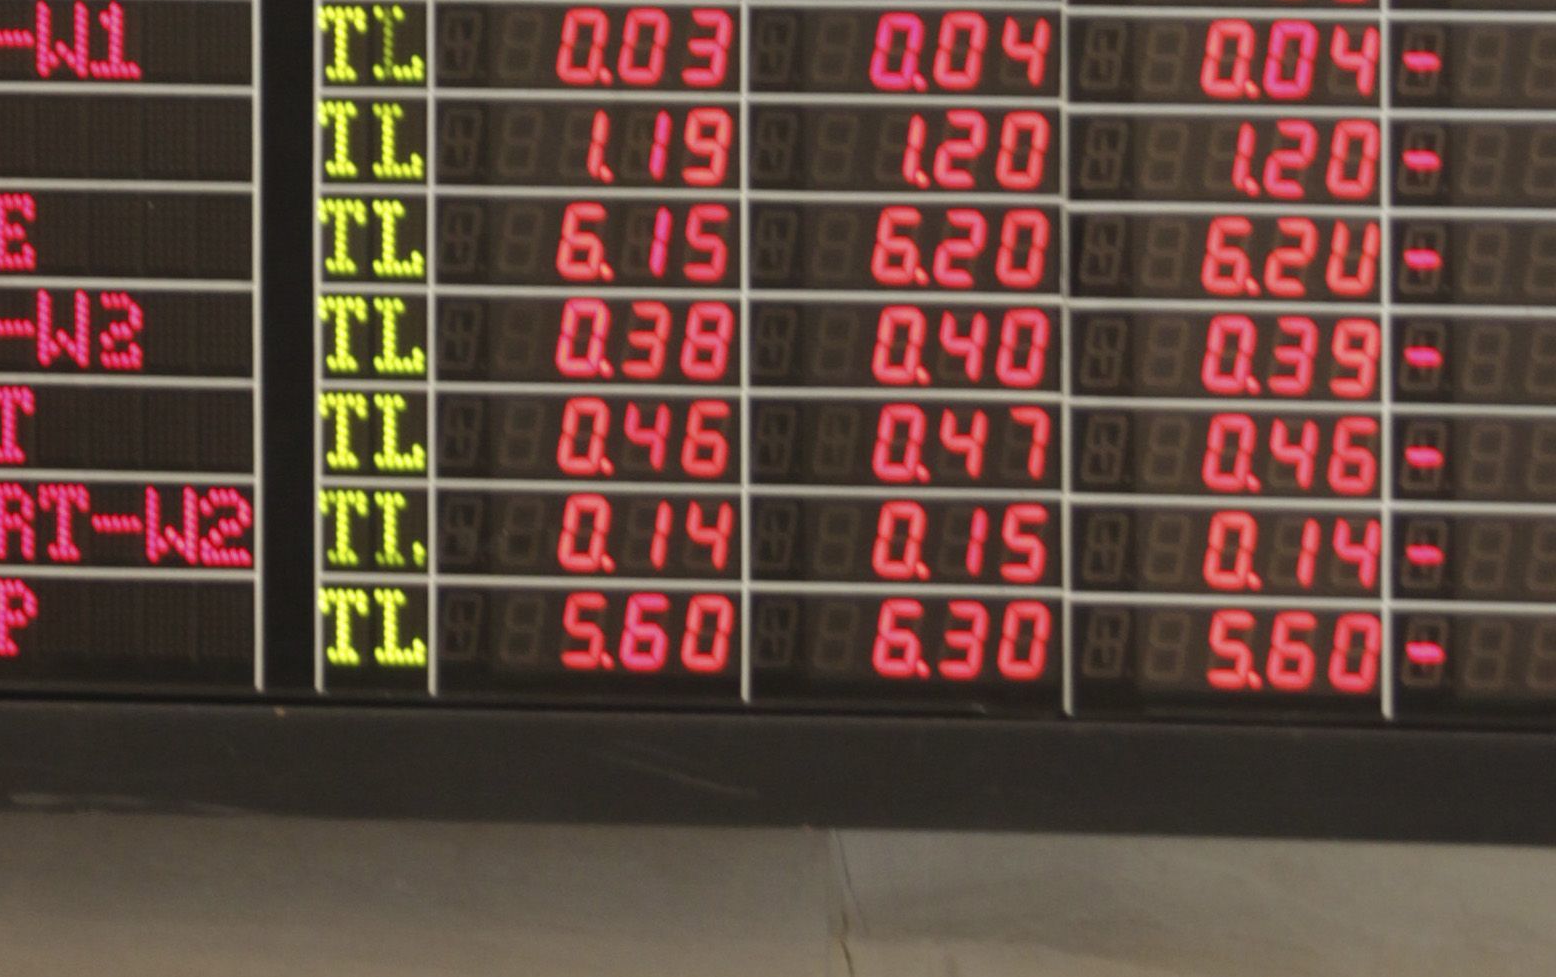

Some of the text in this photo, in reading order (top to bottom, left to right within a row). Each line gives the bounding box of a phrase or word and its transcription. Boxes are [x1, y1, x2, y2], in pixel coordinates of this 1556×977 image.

[320, 5, 424, 81] TL
[556, 6, 733, 87] 0.03
[869, 10, 1051, 92] 0.04
[1200, 18, 1380, 100] 0.04
[320, 101, 423, 178] TL
[587, 107, 733, 186] 1.19
[902, 108, 1050, 190] 1.20
[1231, 118, 1381, 200] 1.20
[319, 198, 424, 276] TL
[556, 201, 730, 282] 6.15
[871, 205, 1050, 288] 6.20
[320, 295, 425, 373] TL
[555, 297, 734, 380] 0.38
[871, 304, 1050, 388] 0.40
[1201, 312, 1381, 399] 0.39
[320, 393, 426, 470] TL
[557, 396, 730, 477] 0.46
[872, 403, 1050, 483] 0.47
[1202, 412, 1378, 495] 0.46
[557, 492, 733, 573] 0.14
[872, 499, 1048, 583] 0.15
[1203, 509, 1381, 591] 0.14
[319, 587, 426, 666] TL
[561, 592, 734, 672] 5.60
[872, 598, 1051, 680] 6.30
[1207, 607, 1381, 693] 5.60
